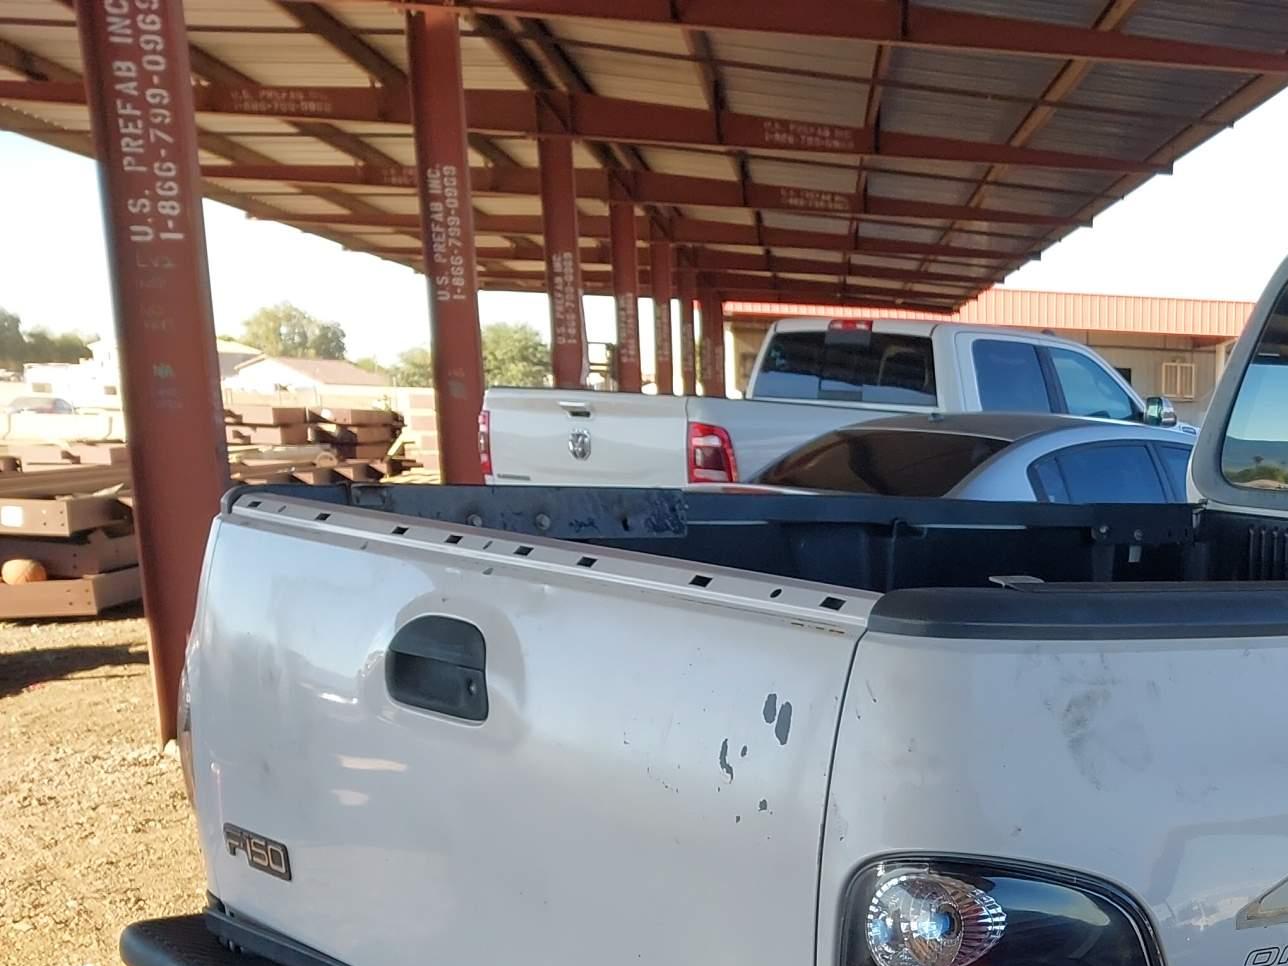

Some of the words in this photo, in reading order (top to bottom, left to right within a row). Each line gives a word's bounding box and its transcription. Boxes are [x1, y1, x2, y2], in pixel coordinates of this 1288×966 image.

[111, 60, 148, 172] PREFAB
[126, 189, 154, 242] U.S.
[429, 201, 447, 263] PREFAB
